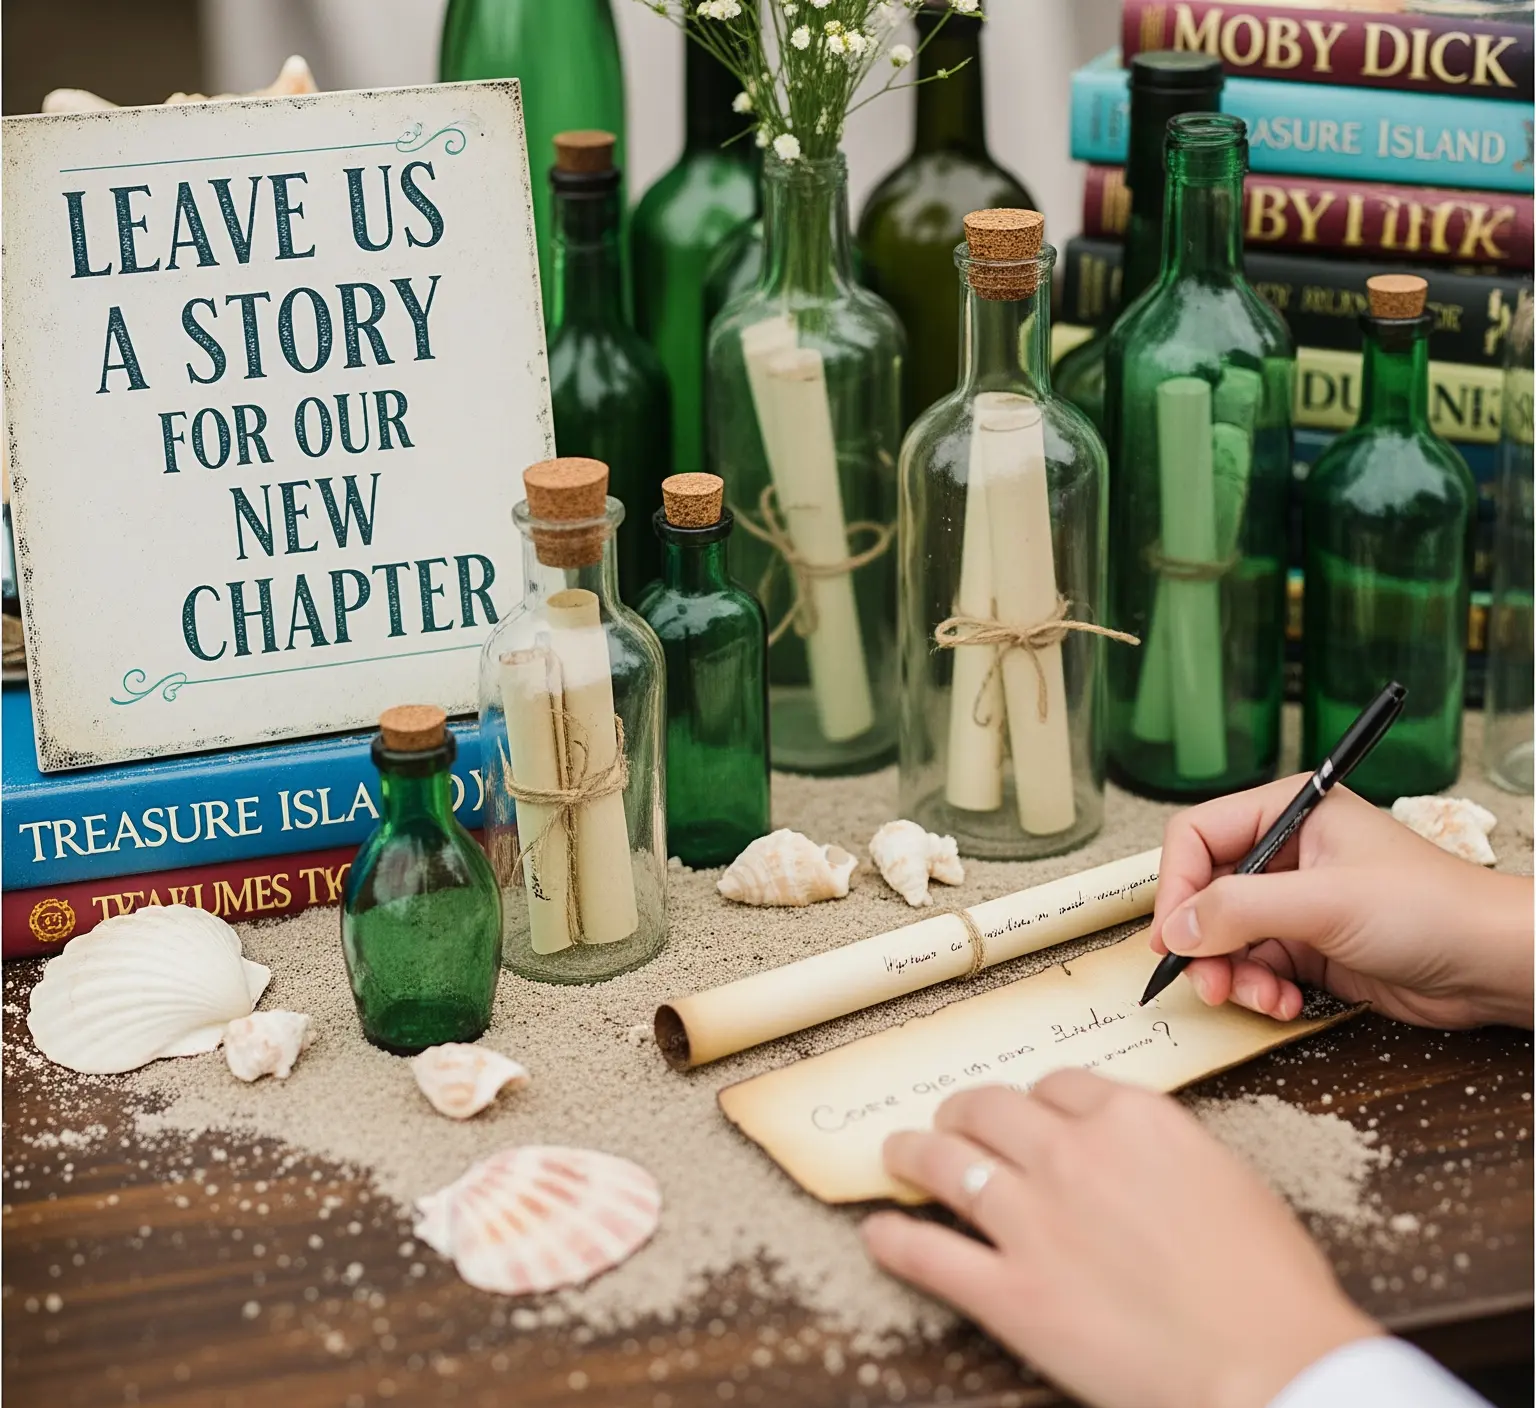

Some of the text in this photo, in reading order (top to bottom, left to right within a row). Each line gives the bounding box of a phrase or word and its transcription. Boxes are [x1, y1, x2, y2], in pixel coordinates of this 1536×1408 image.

[1173, 3, 1518, 88] MOBY DICK
[1377, 118, 1506, 165] ISLAND
[62, 161, 445, 279] LEAVE US
[96, 275, 442, 394] A STORY
[158, 389, 415, 474] FOR OUR
[229, 473, 382, 560] NEW
[182, 553, 501, 662] CHAPTER
[19, 796, 263, 863] TREASURE
